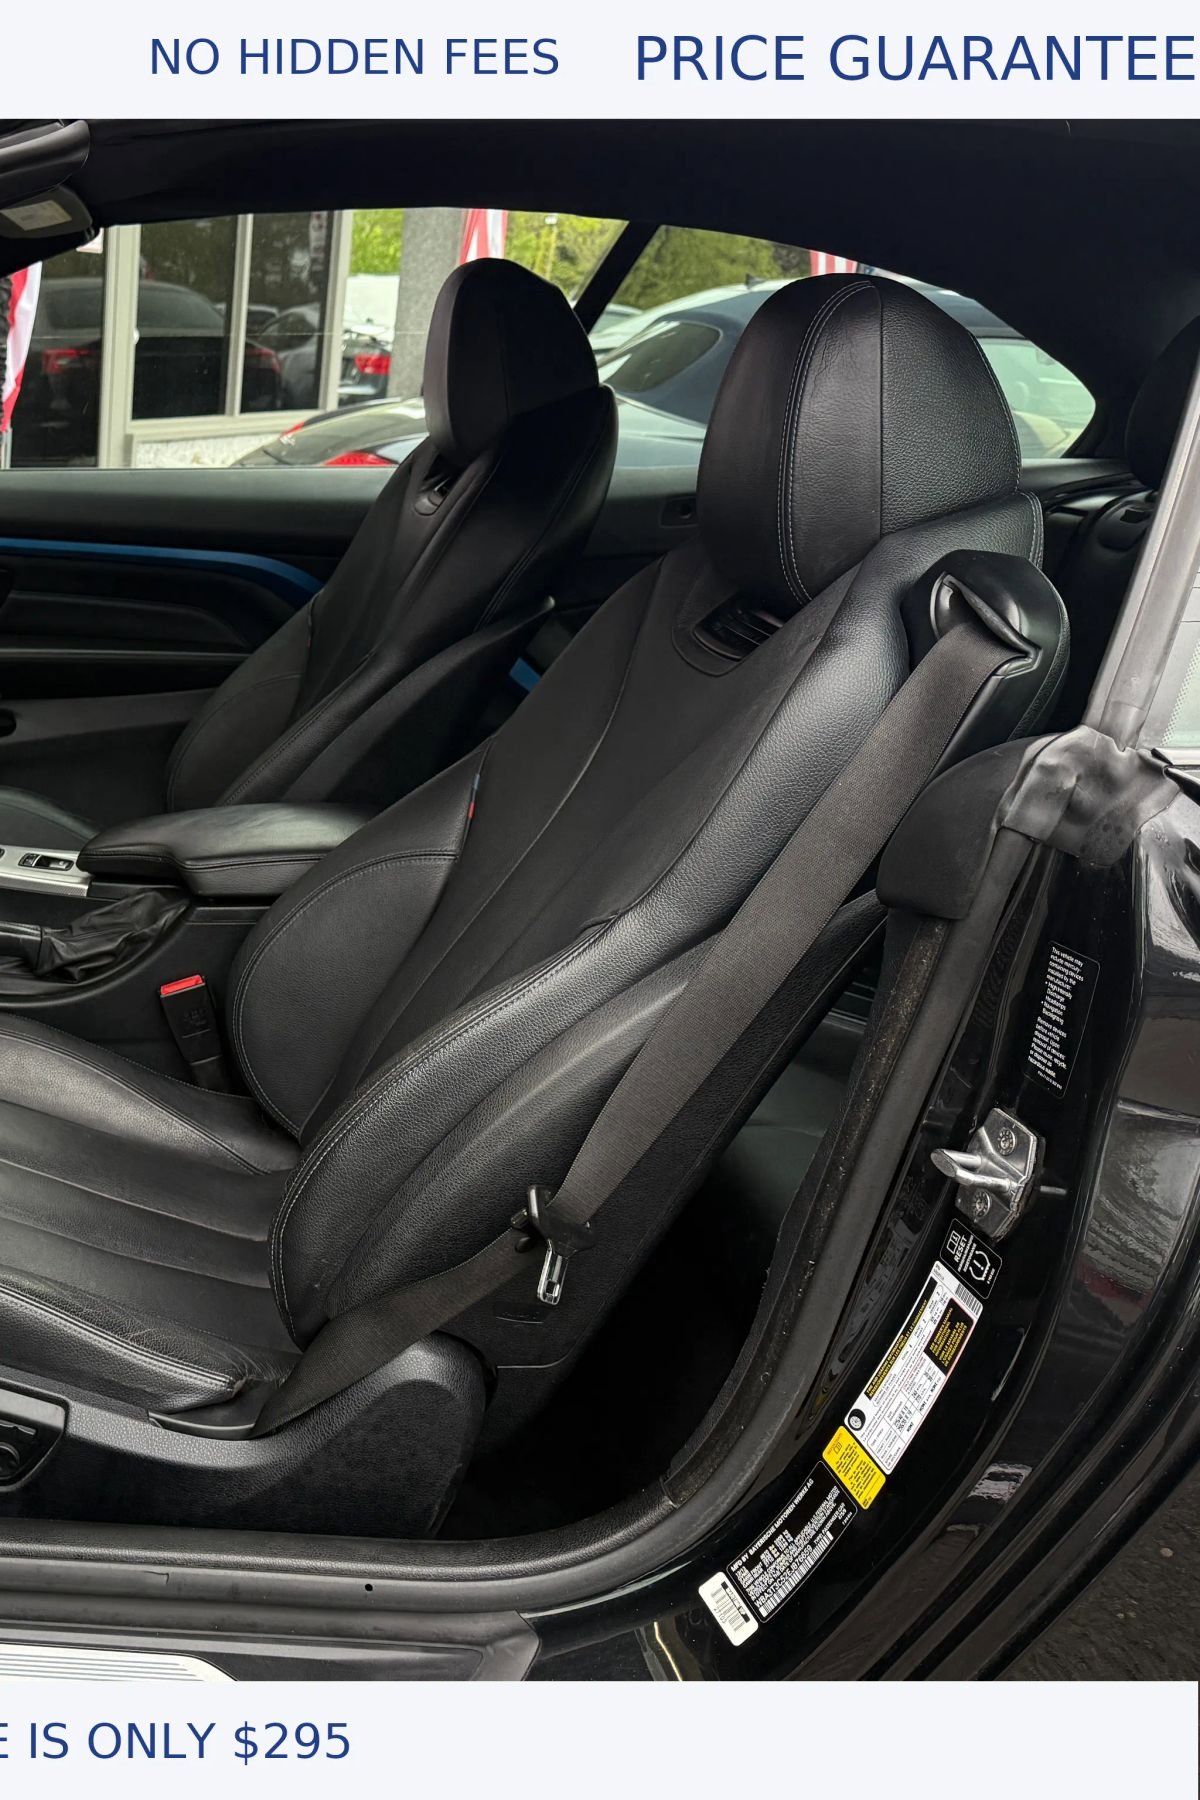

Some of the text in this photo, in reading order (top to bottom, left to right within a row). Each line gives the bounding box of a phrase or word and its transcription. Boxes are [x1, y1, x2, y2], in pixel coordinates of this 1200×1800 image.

[954, 1235, 967, 1262] RESET
[731, 1560, 742, 1572] MFD
[742, 1553, 748, 1562] BY
[749, 1526, 776, 1555] BAYERISCHE
[774, 1503, 795, 1528] MOTOREN
[794, 1486, 808, 1504] WERKE
[807, 1479, 814, 1488] AG
